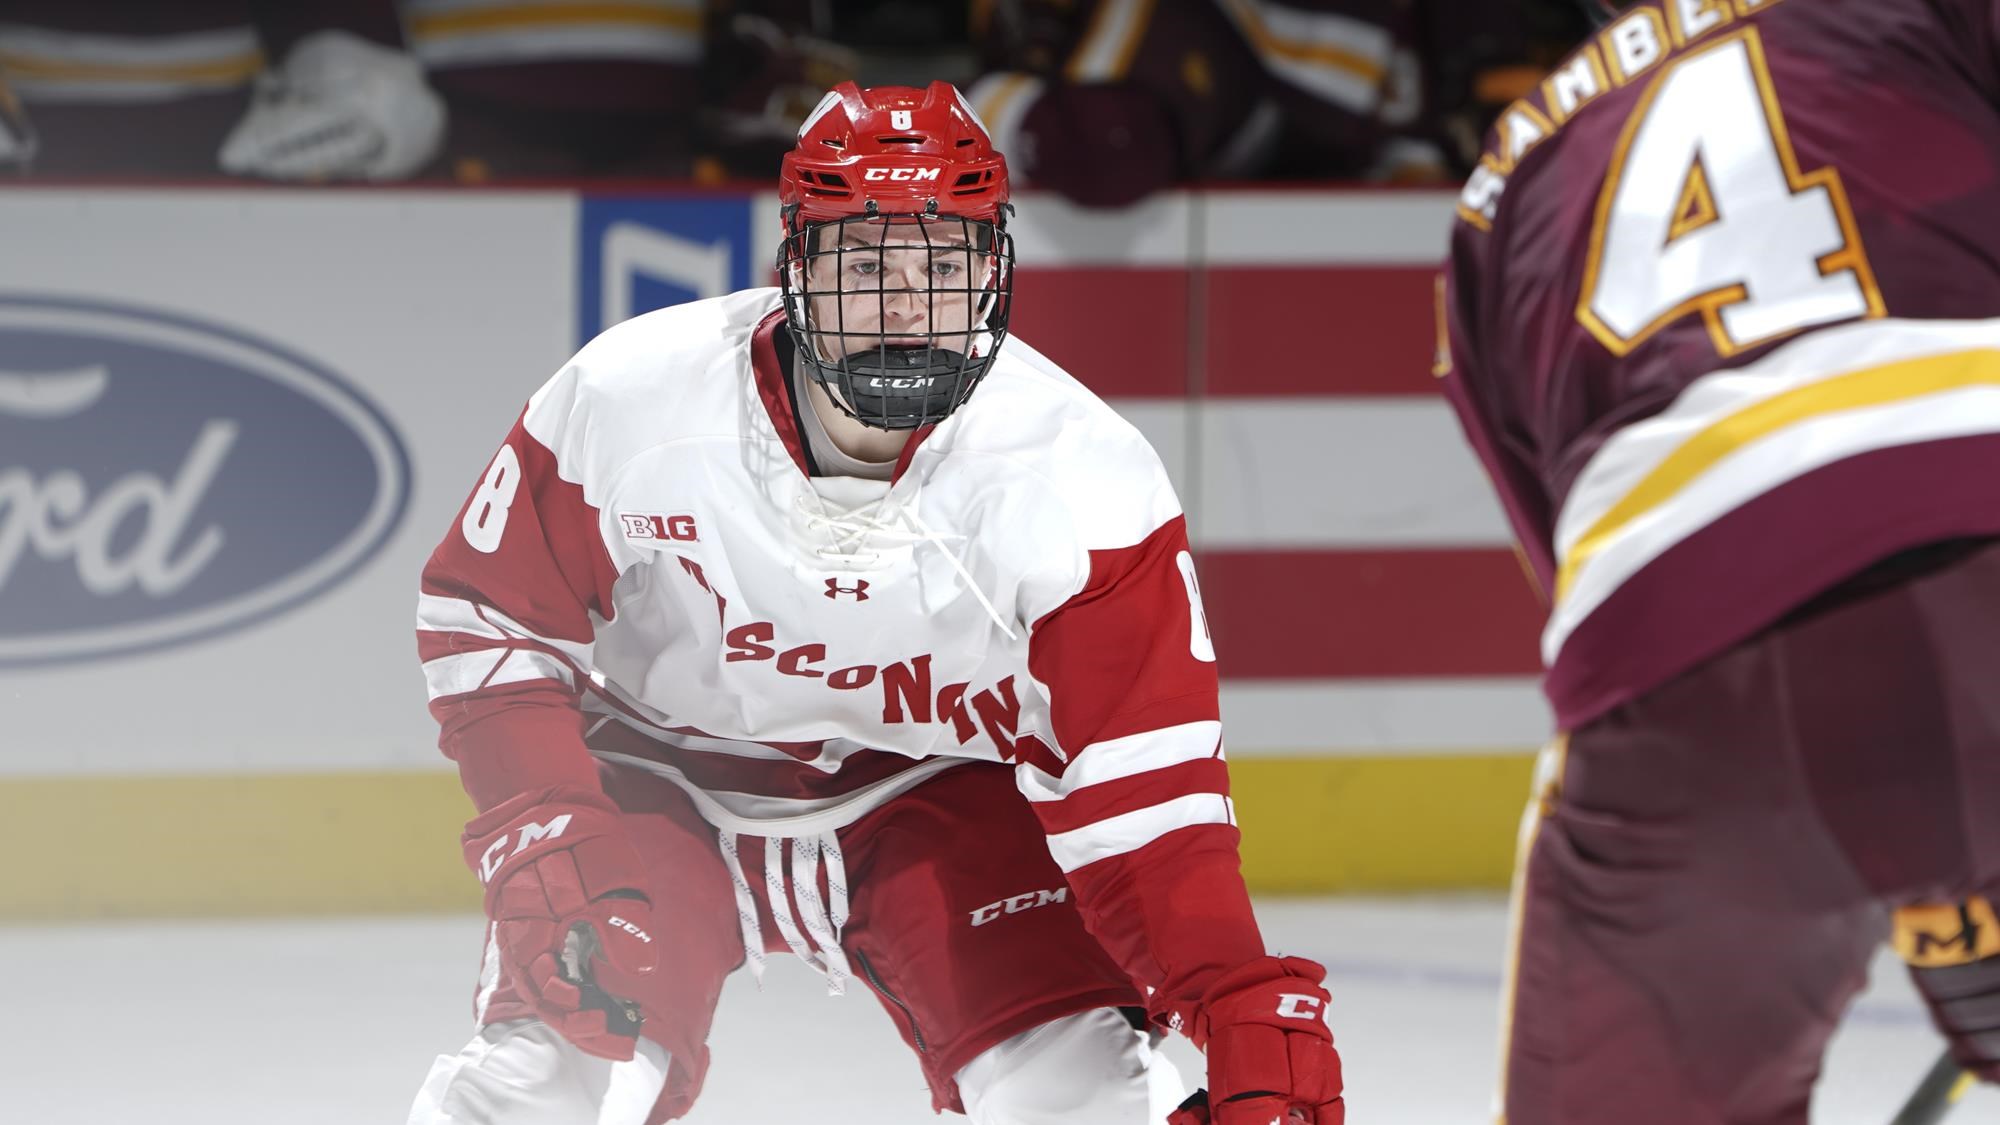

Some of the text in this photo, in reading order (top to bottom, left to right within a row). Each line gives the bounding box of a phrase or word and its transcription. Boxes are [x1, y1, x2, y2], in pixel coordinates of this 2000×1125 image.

[1456, 0, 1775, 232] SAMBE
[864, 167, 941, 182] CCM
[1575, 24, 1888, 358] 4
[869, 377, 935, 389] CCM
[0, 365, 240, 594] rd
[462, 444, 521, 553] 8
[478, 814, 573, 883] CM
[608, 916, 651, 943] CCM
[968, 887, 1068, 927] CCM
